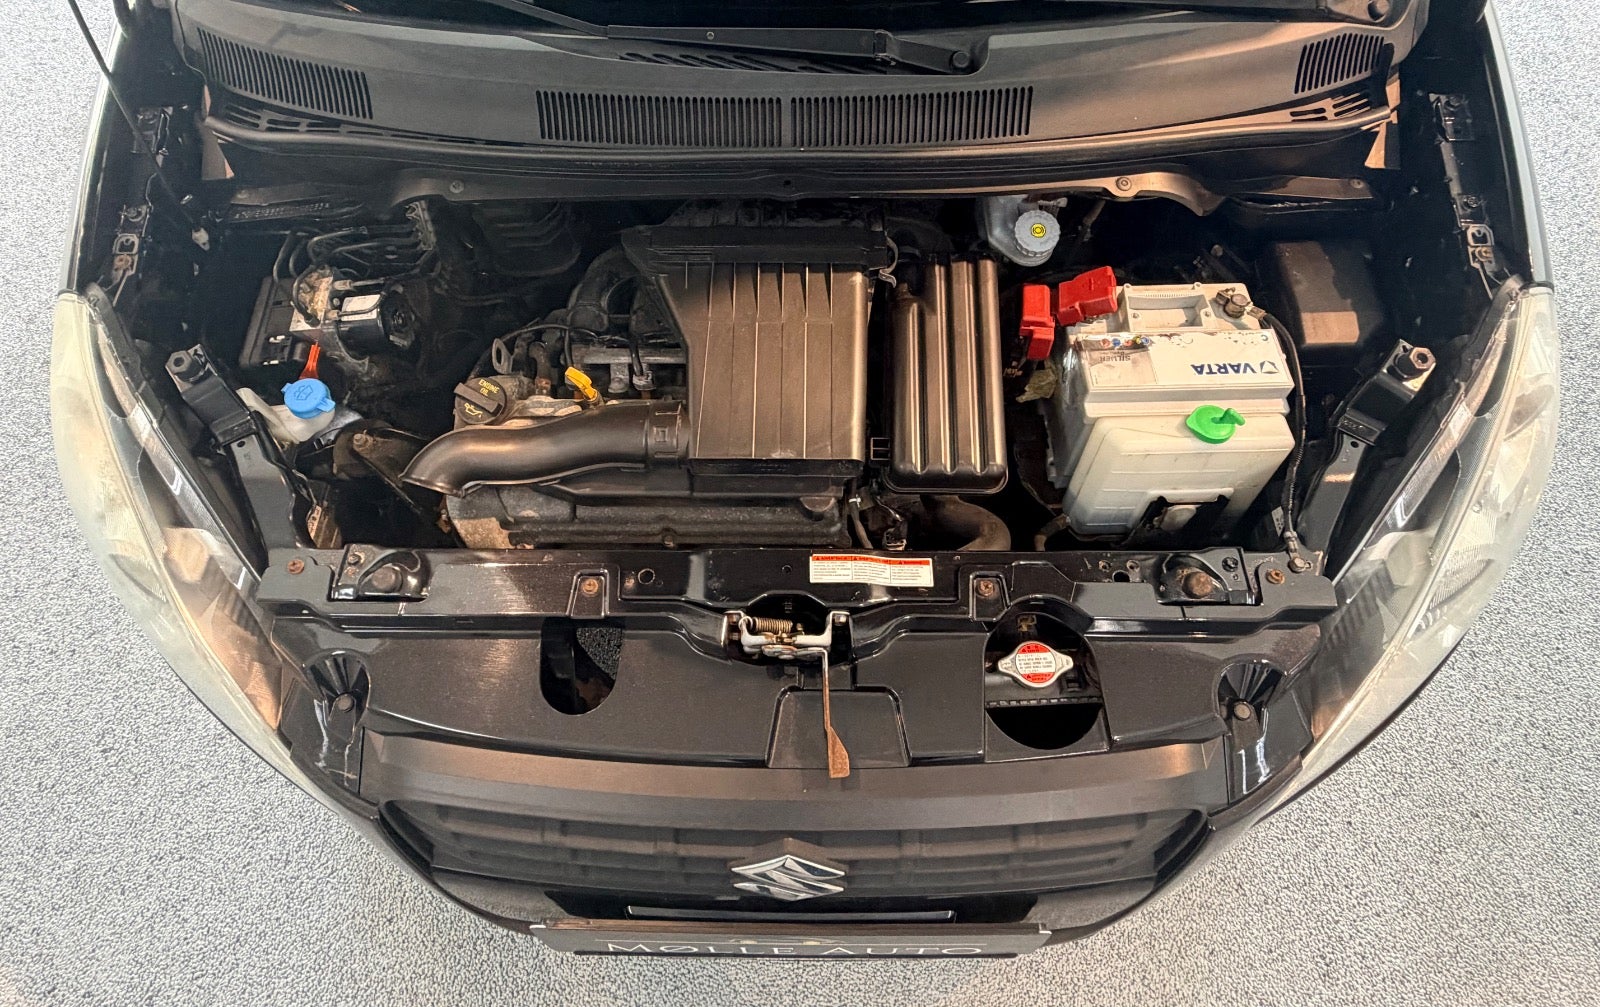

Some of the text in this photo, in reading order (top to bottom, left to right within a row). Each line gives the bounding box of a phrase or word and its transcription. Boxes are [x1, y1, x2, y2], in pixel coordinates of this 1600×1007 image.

[1190, 362, 1258, 375] VARTA
[479, 379, 500, 393] ENGINE
[480, 388, 488, 396] OIL
[607, 943, 982, 955] MØLLE AUTO
